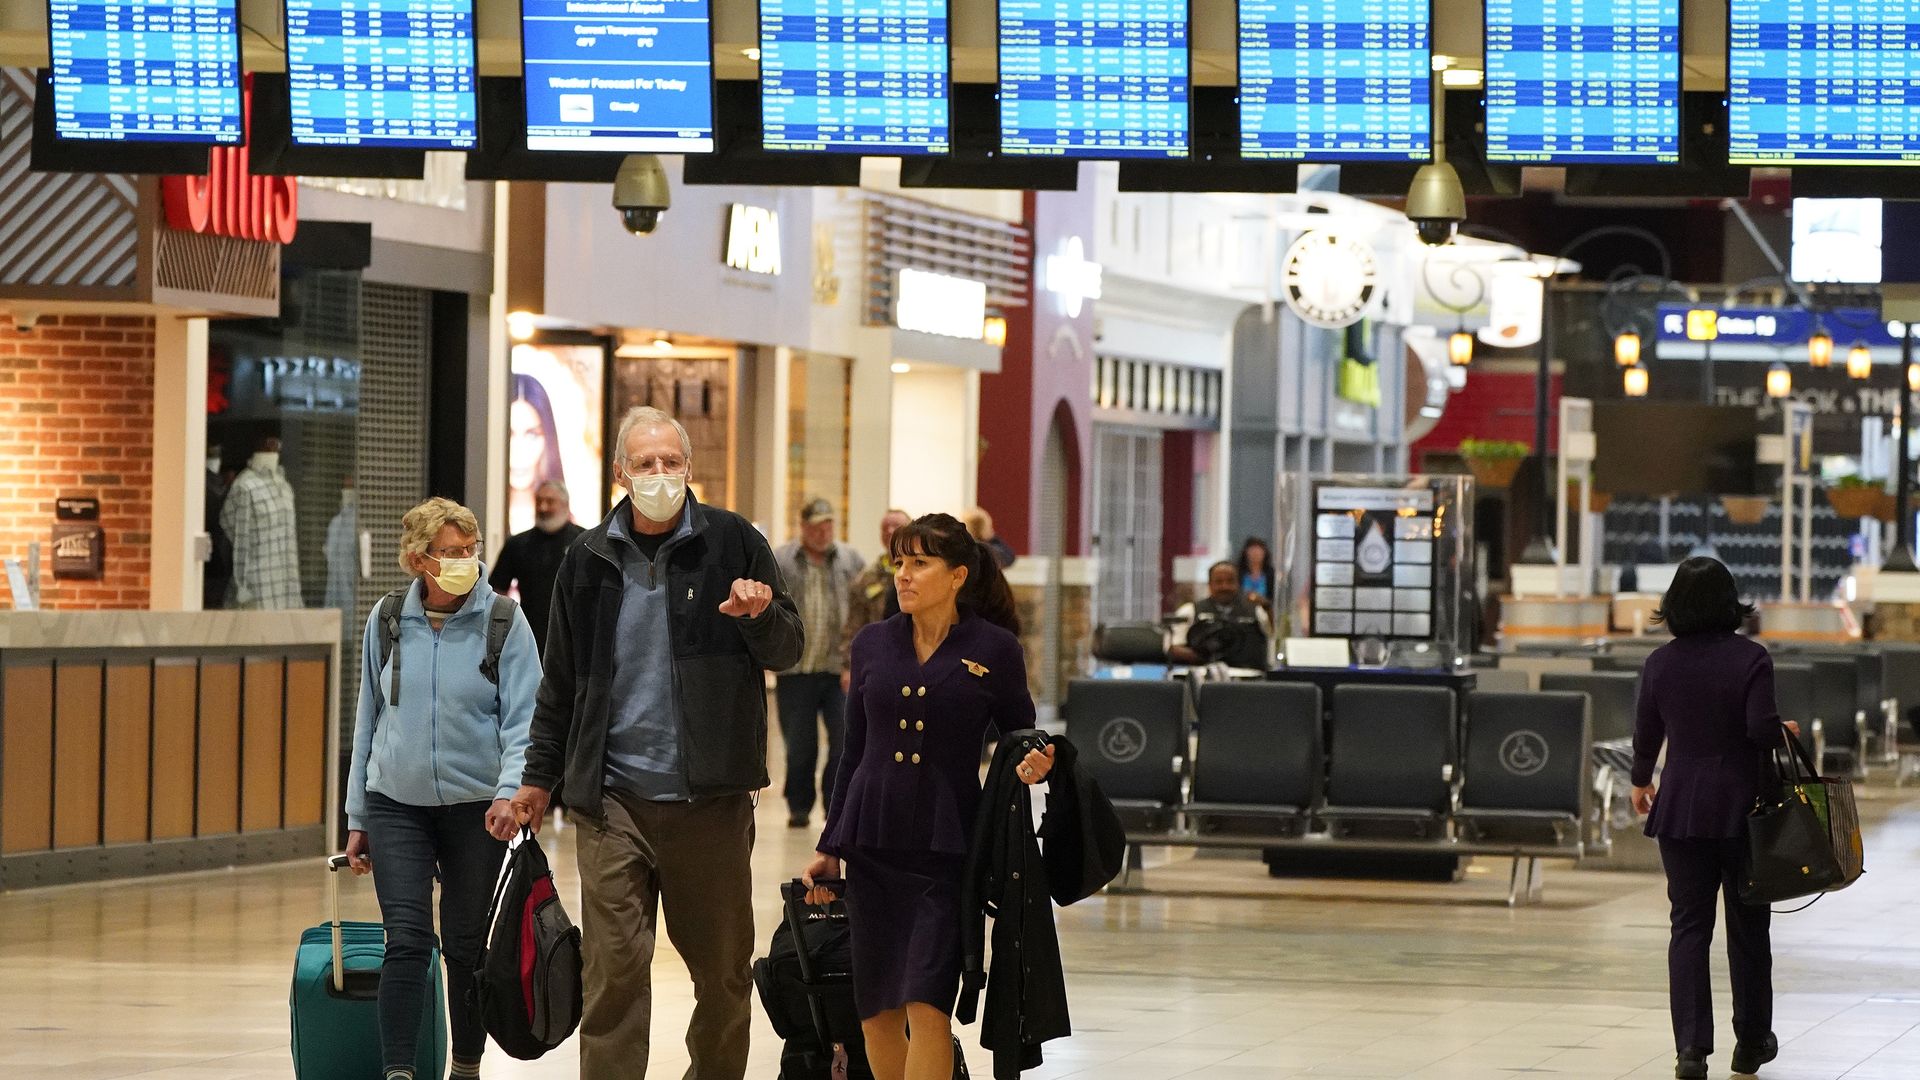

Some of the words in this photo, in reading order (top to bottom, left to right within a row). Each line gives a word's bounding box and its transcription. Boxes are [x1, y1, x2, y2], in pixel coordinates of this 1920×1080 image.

[567, 2, 628, 13] International
[630, 3, 665, 14] Airport
[549, 77, 590, 88] Weather
[591, 78, 634, 89] Forecast
[636, 79, 654, 89] For
[655, 79, 686, 91] Today
